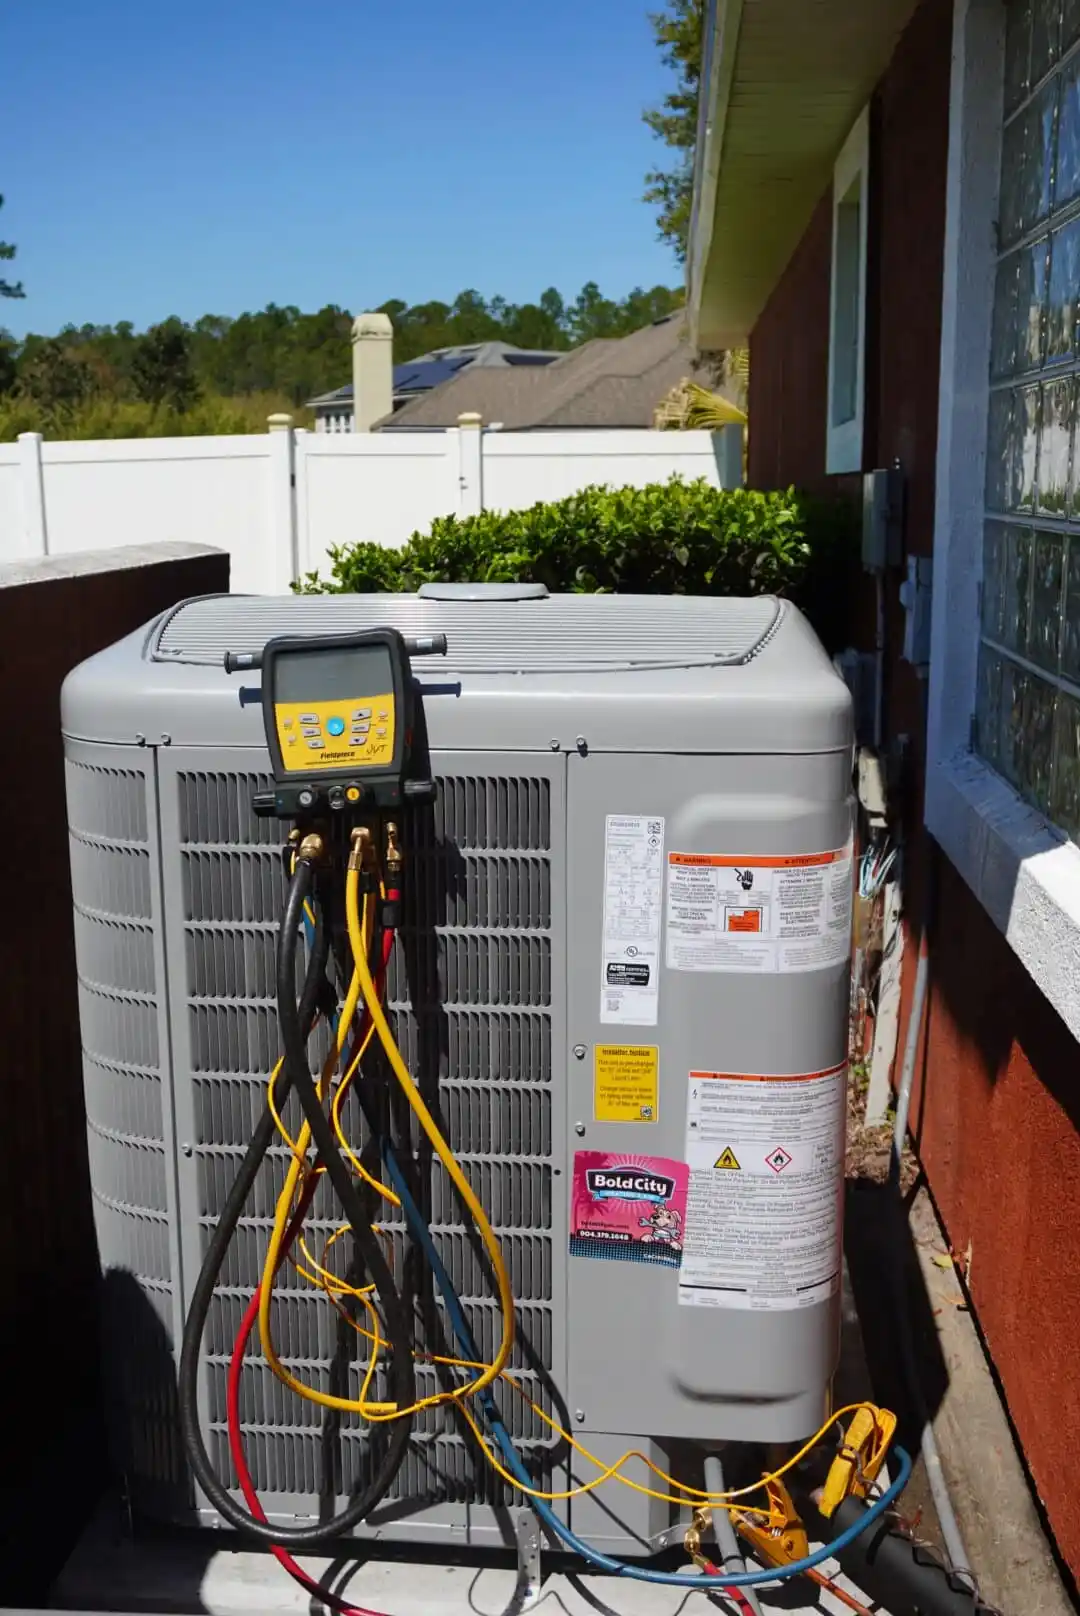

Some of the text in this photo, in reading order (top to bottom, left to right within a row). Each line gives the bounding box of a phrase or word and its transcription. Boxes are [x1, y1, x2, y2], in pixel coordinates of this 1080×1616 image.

[320, 752, 355, 760] Fieldpiece
[594, 1174, 667, 1196] Bold City
